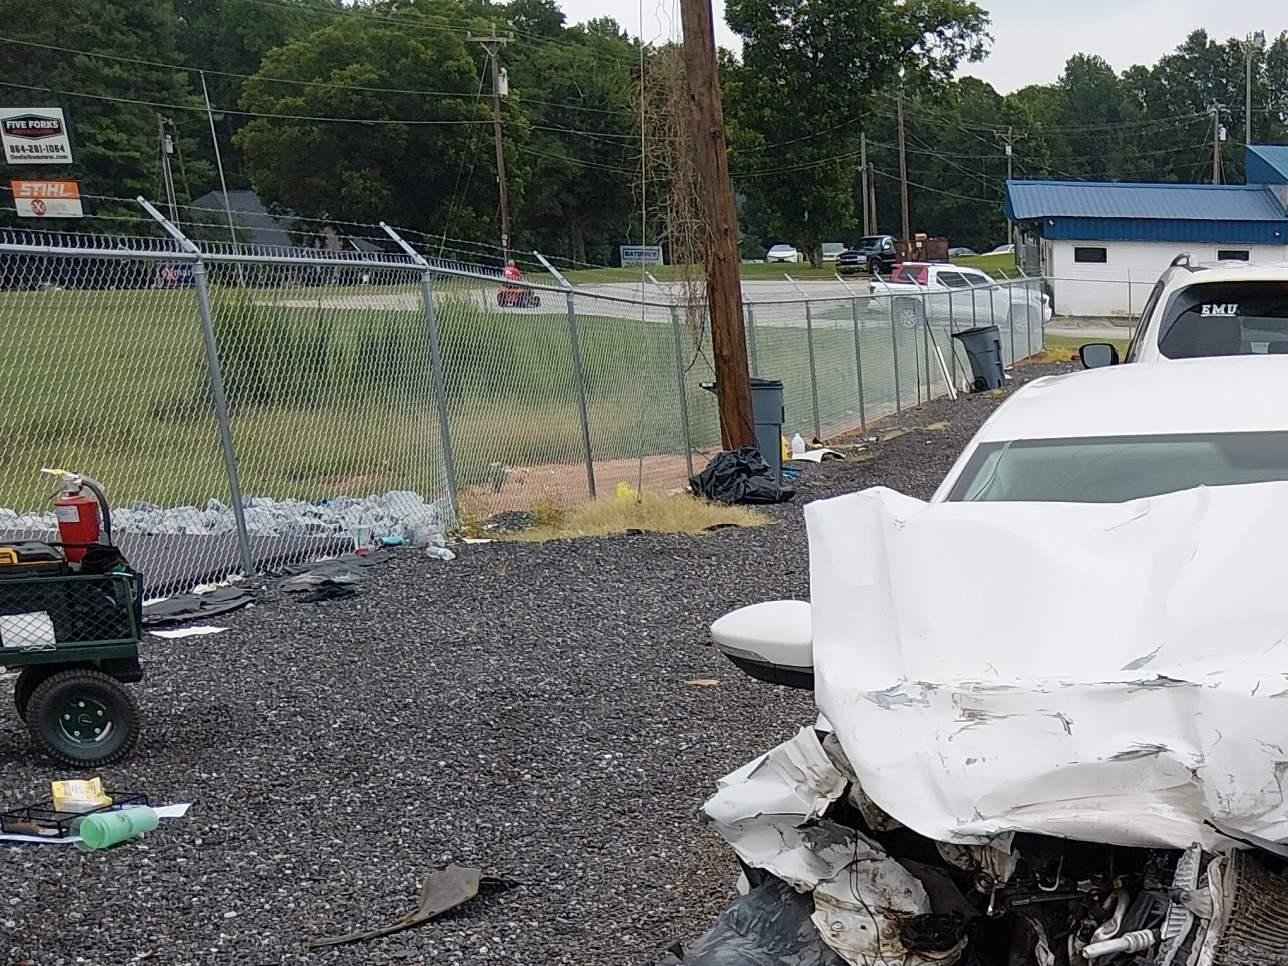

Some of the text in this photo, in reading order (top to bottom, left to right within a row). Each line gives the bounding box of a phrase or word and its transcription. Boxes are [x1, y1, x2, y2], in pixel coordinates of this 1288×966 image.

[6, 120, 59, 129] FIVE FORKS
[20, 183, 71, 197] STIHL
[1200, 303, 1239, 315] EMU
